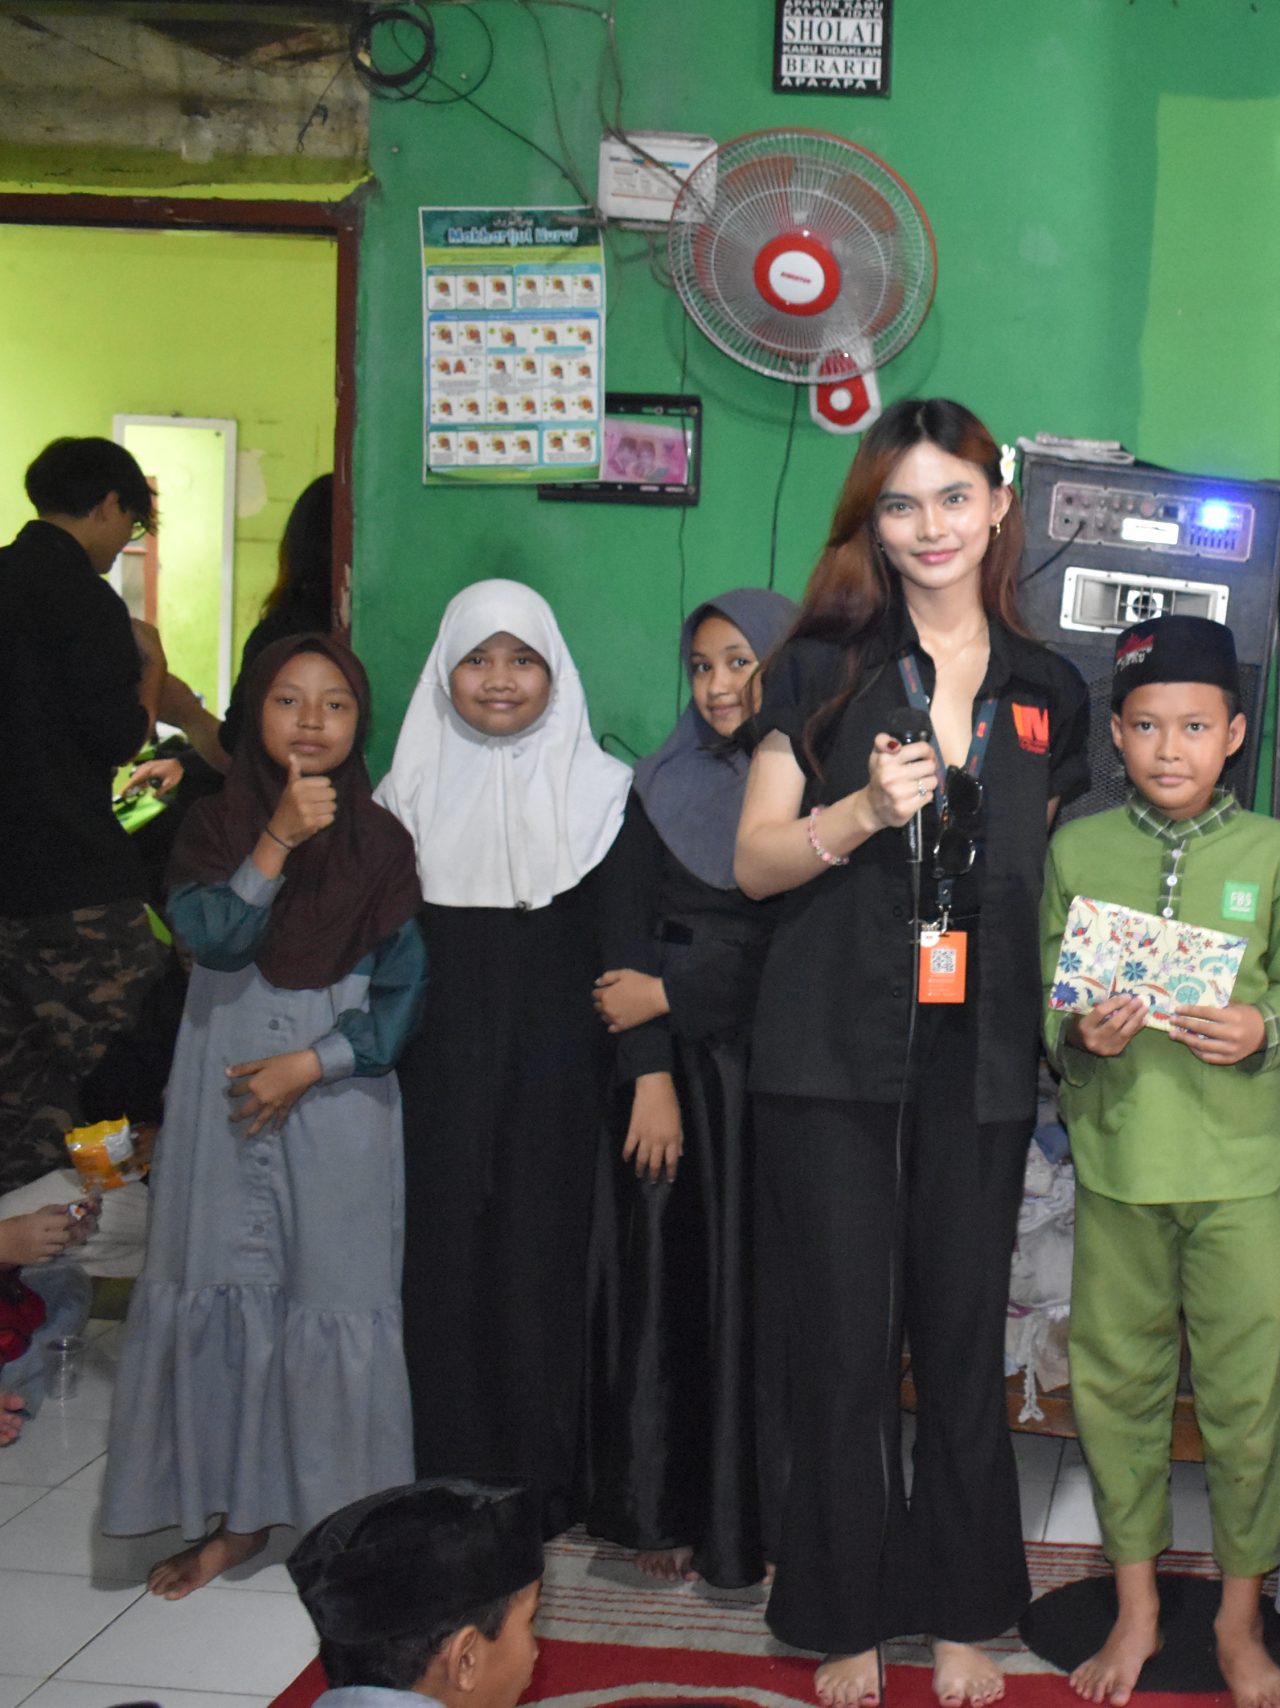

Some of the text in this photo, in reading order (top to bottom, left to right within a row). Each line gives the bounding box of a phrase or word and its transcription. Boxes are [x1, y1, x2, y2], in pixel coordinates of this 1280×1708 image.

[840, 8, 883, 19] TIDAK
[785, 19, 881, 42] SHOLAT
[783, 44, 881, 57] KAMU TIDAKLAH
[786, 58, 877, 76] BERARTI
[781, 77, 866, 90] APA-APA
